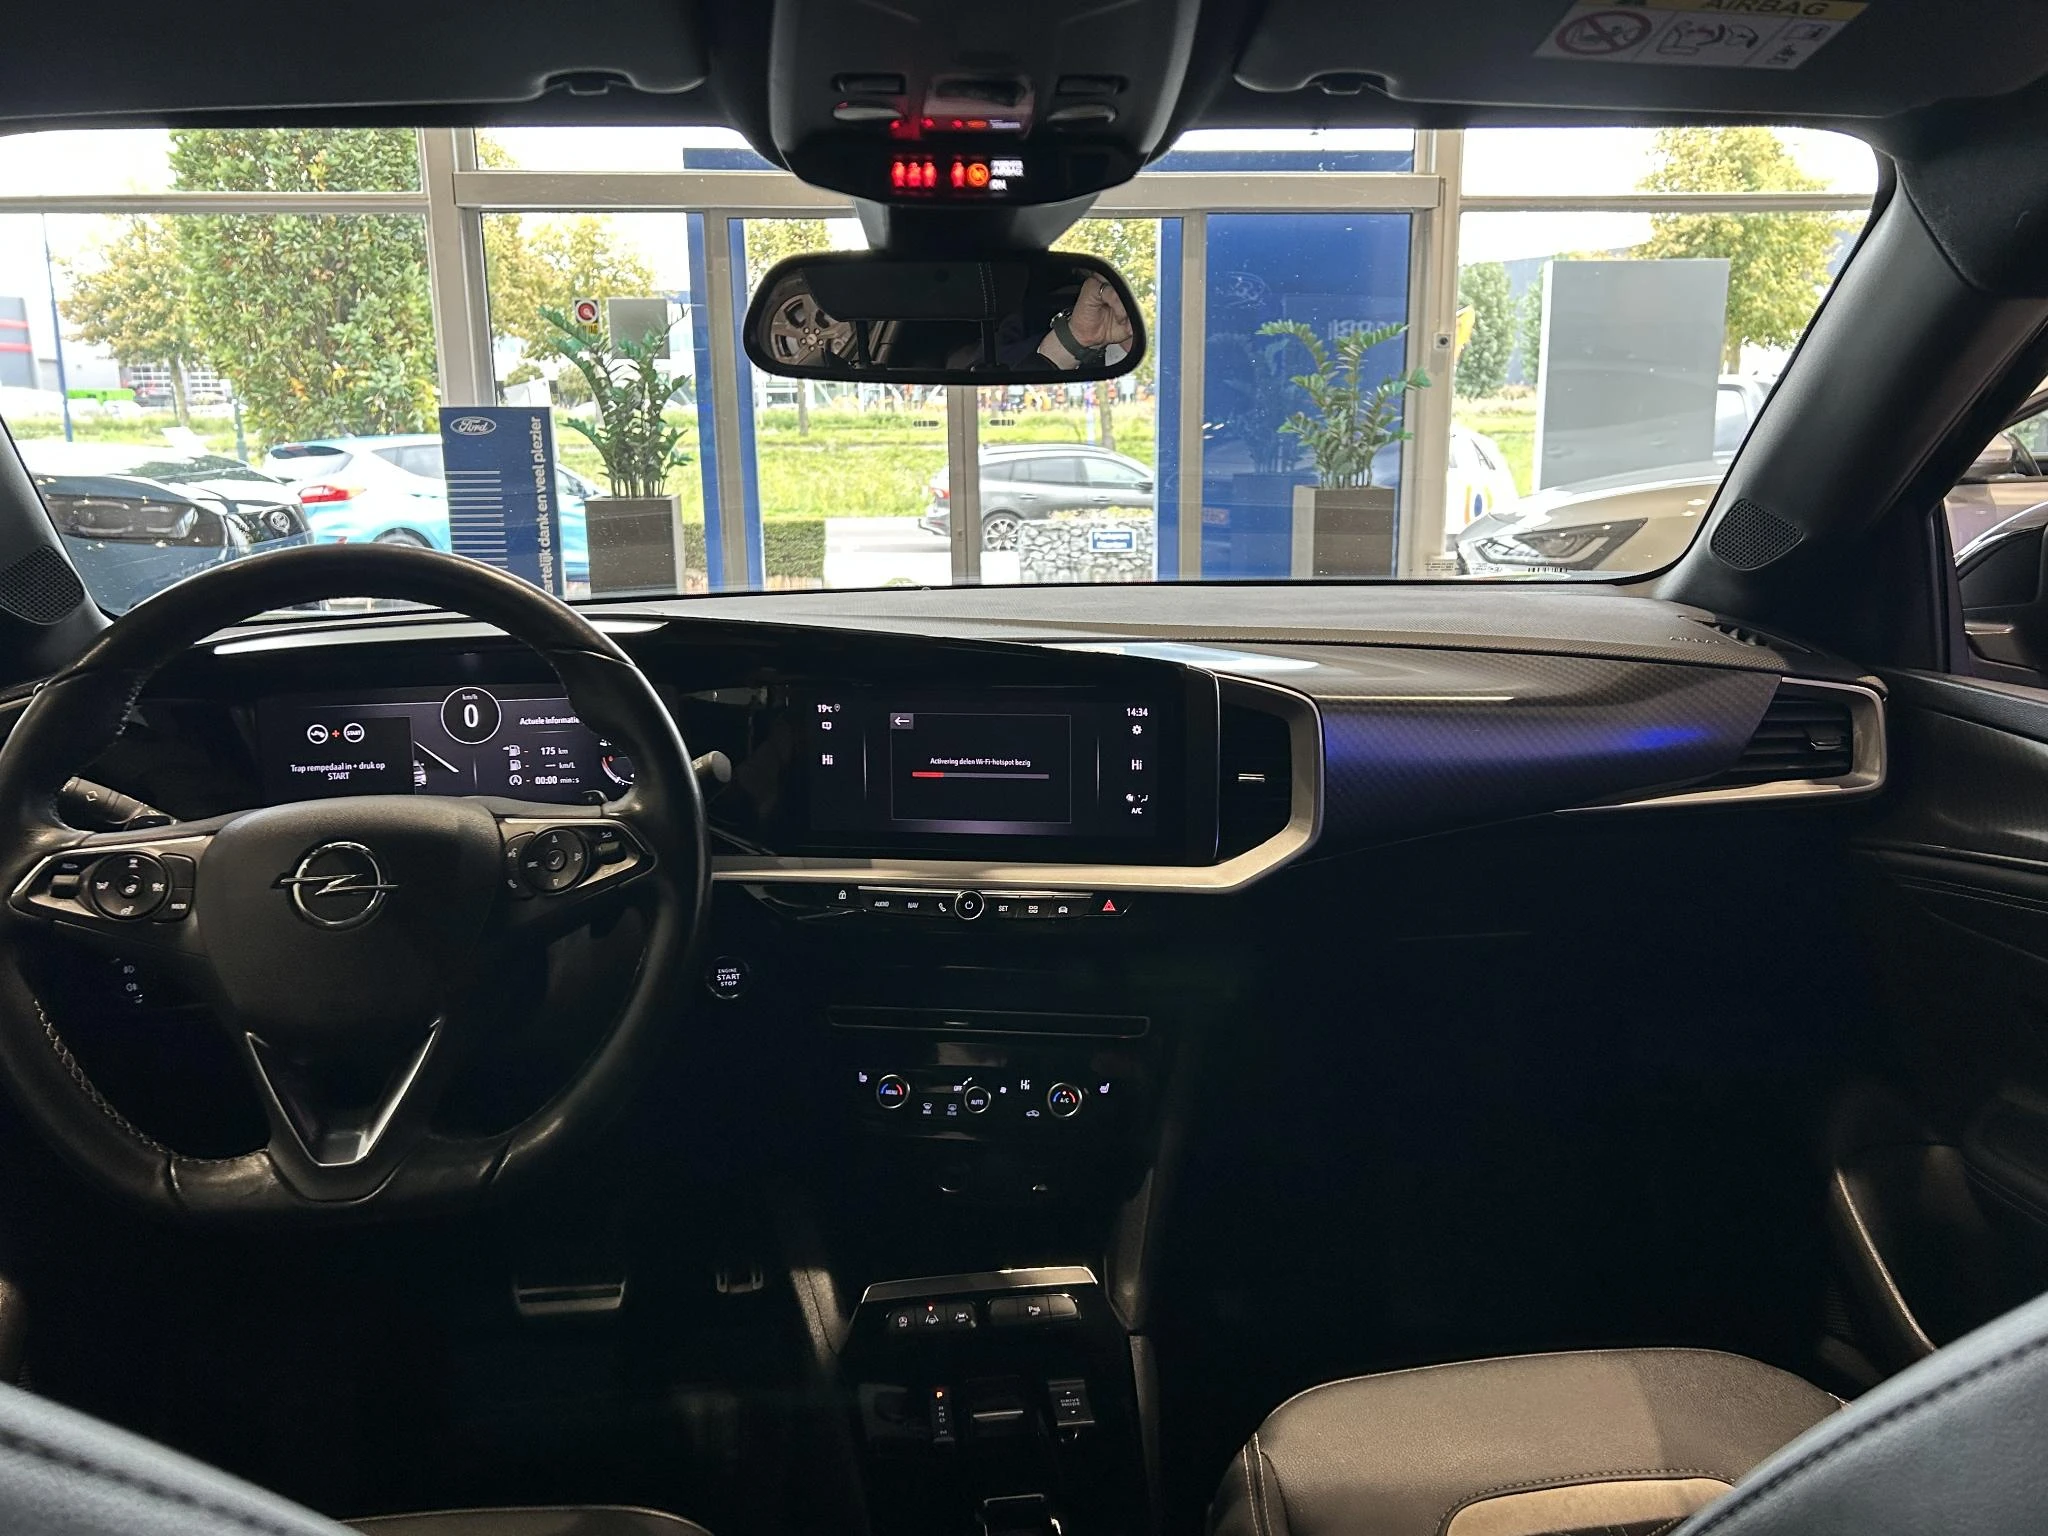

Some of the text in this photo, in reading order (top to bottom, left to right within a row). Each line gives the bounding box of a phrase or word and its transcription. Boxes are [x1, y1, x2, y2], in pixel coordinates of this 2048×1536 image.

[530, 416, 554, 595] artelijk dank en veel plezier
[463, 704, 479, 728] 0
[1126, 707, 1149, 717] 14:34
[519, 716, 544, 725] Actuele
[540, 747, 556, 755] 175
[821, 754, 834, 765] Hi
[929, 757, 959, 767] Activering
[976, 758, 1015, 767] Wi-Fi-hotspot
[1015, 759, 1031, 768] bezig
[1131, 759, 1143, 770] Hi
[290, 764, 306, 773] Trap
[307, 762, 345, 773] rempedaal
[345, 762, 352, 770] in
[359, 762, 375, 770] druk
[375, 763, 386, 771] op
[327, 772, 350, 781] START
[535, 776, 558, 785] 00:00
[1131, 807, 1143, 815] A/C
[716, 973, 741, 981] START
[1020, 1079, 1031, 1091] Hi
